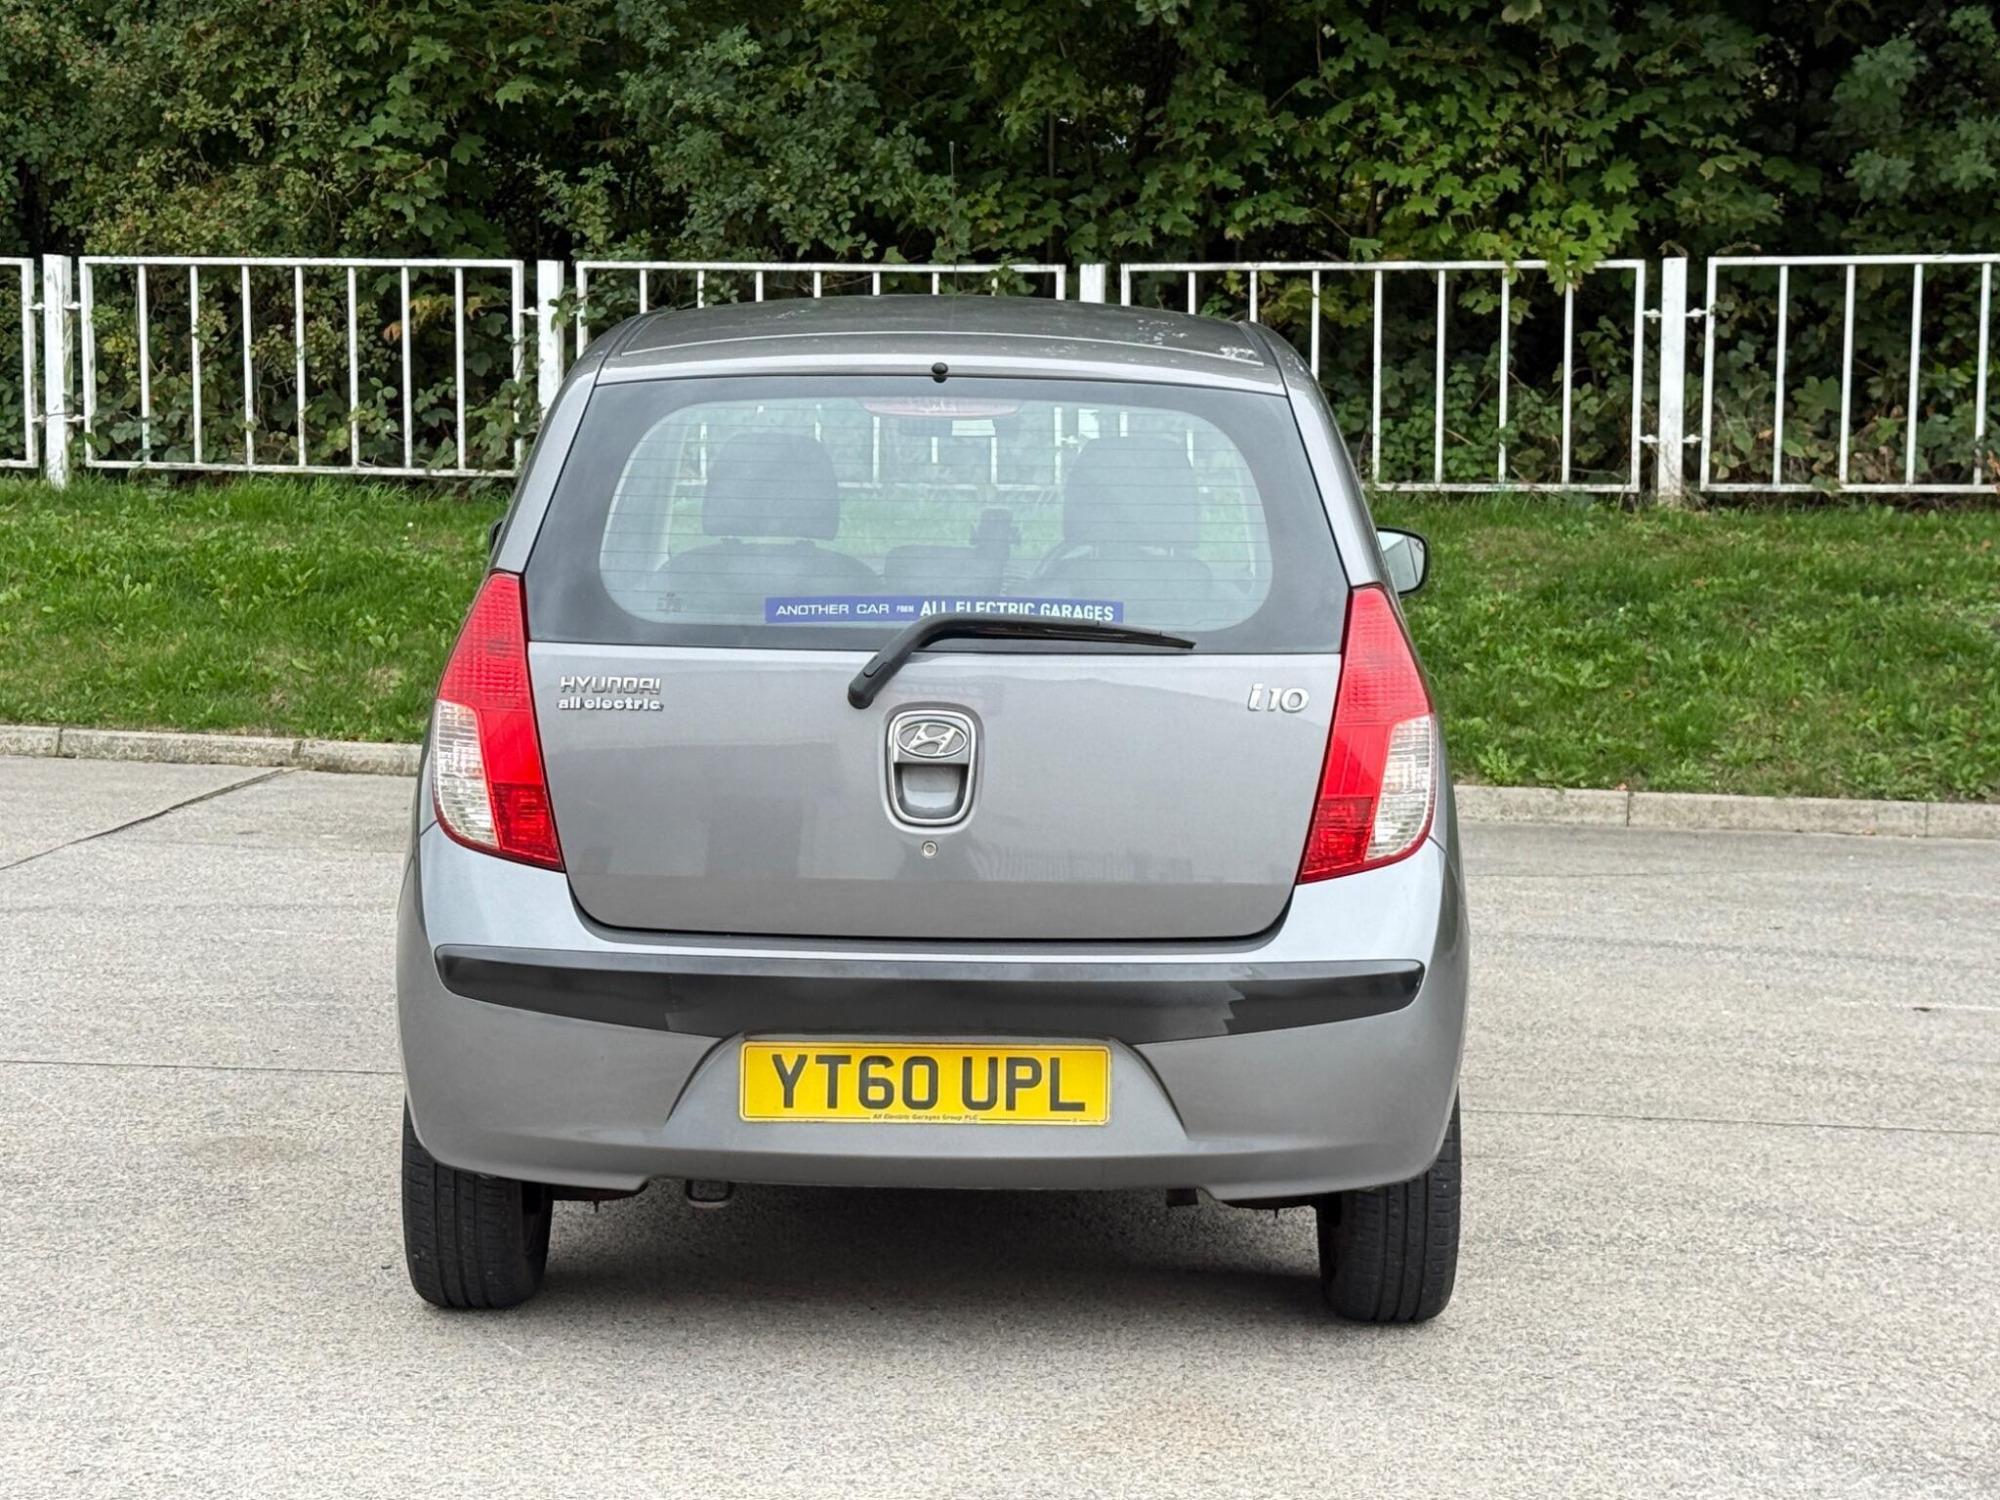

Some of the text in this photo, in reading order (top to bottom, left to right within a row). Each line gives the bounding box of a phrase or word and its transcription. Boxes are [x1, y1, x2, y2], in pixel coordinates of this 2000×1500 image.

[776, 604, 849, 615] ANOTHER
[856, 603, 889, 614] CAR
[1040, 603, 1115, 621] GARAGES
[560, 676, 661, 694] HYUNDAI
[558, 696, 662, 711] all electric
[1247, 683, 1310, 713] i10
[771, 1054, 1086, 1112] YT60 UPL
